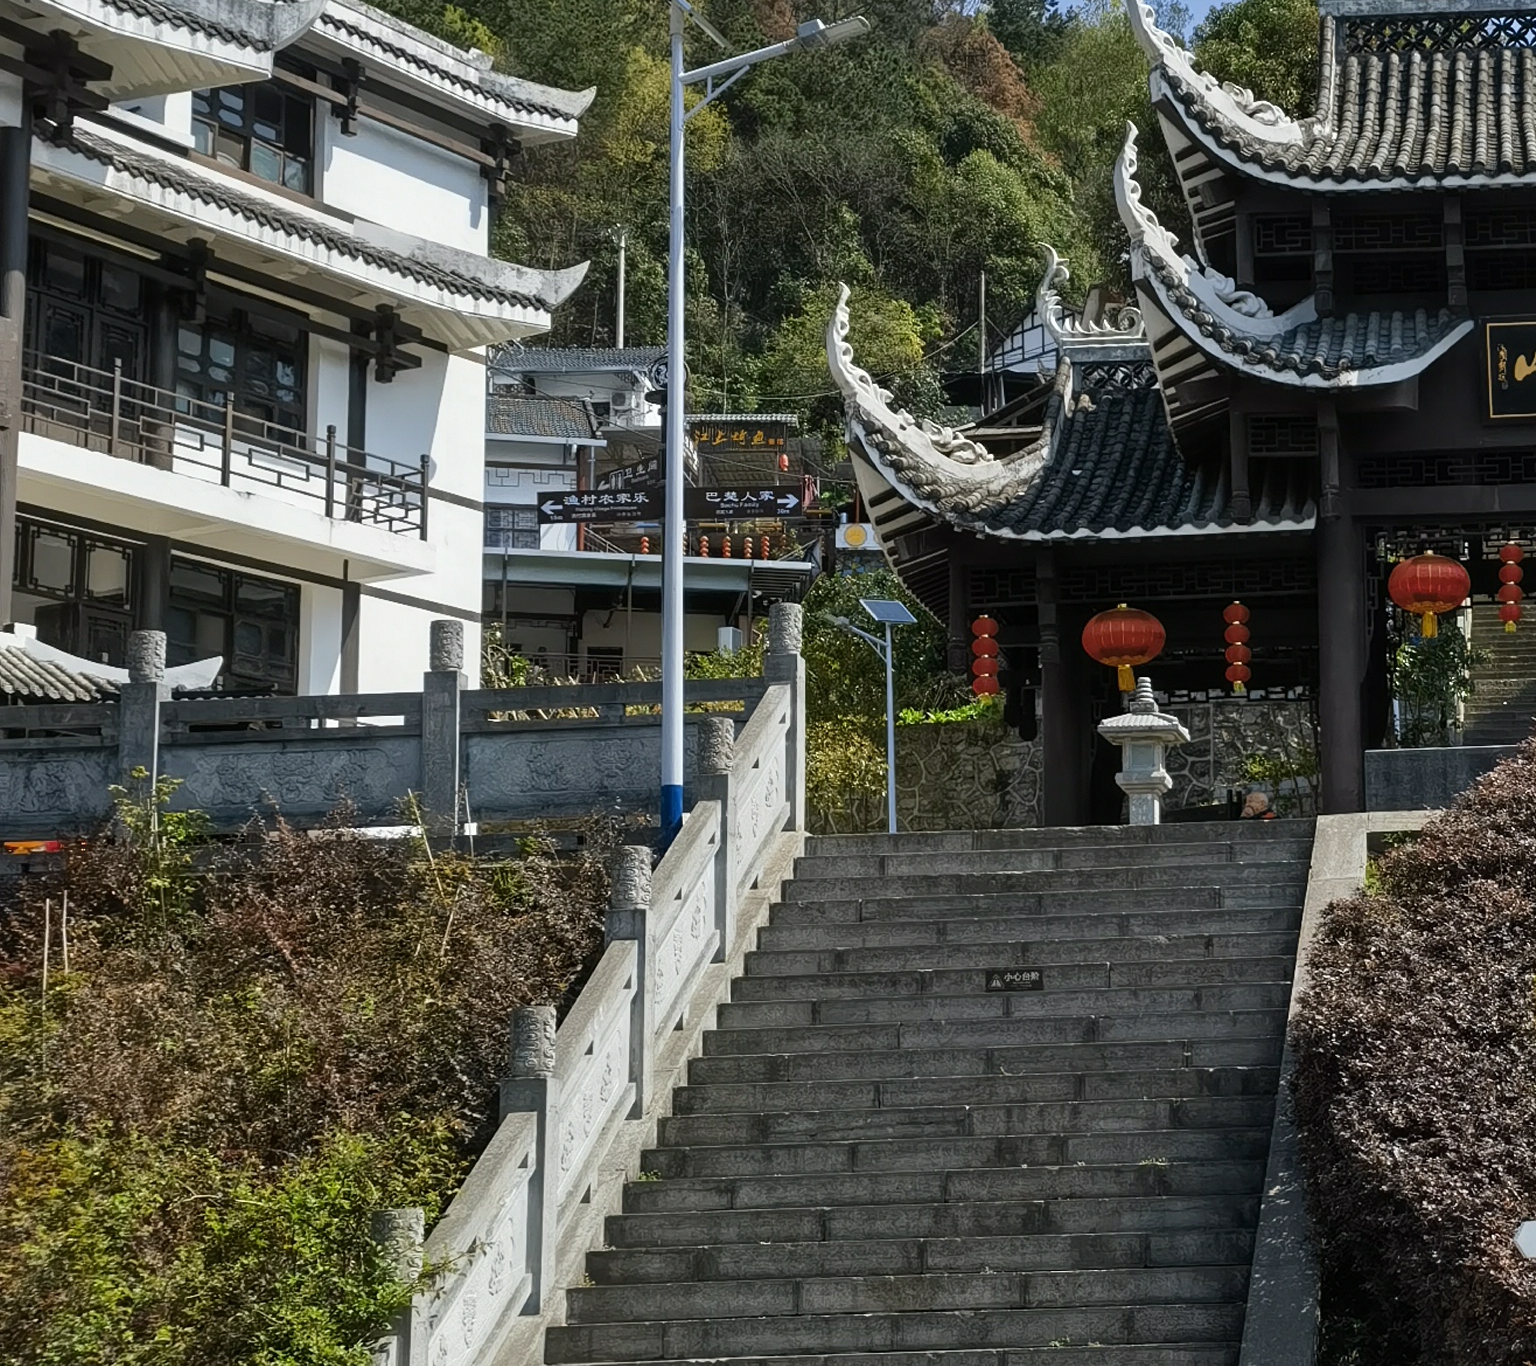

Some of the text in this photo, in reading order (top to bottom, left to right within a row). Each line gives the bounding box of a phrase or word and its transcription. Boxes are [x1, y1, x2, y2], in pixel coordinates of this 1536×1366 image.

[563, 492, 650, 506] 渔村农家乐
[705, 491, 775, 502] 巴楚人家
